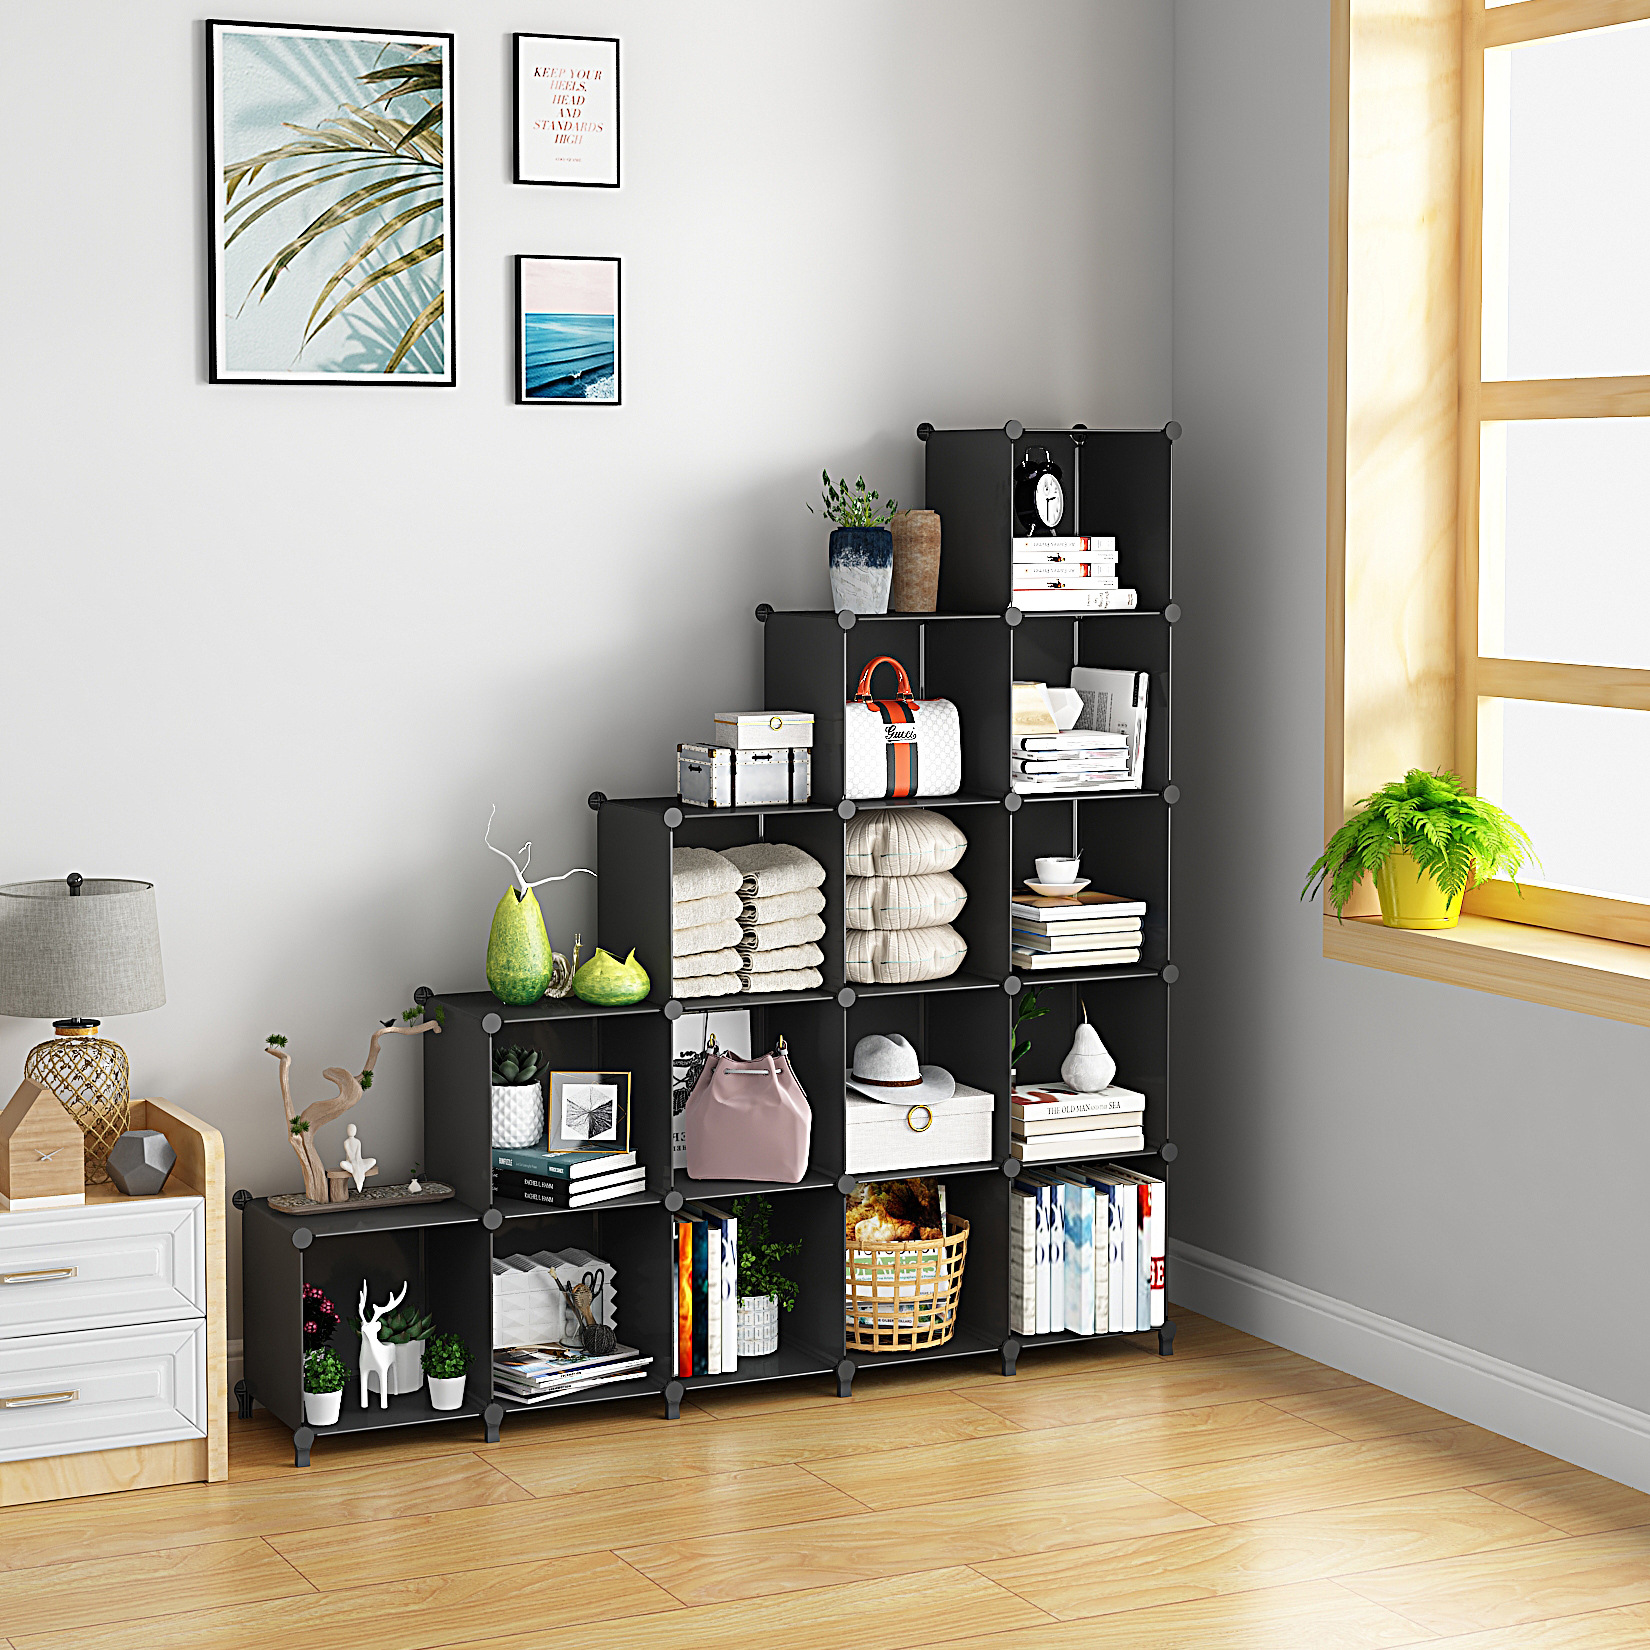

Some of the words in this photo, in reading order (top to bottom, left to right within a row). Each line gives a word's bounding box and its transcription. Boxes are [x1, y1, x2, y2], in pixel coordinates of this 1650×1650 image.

[534, 67, 566, 78] KEEP
[570, 69, 602, 80] YOUR
[552, 94, 586, 106] HEAD
[557, 108, 581, 118] AND
[533, 120, 603, 132] STANDARDS
[554, 134, 583, 145] HIGH
[885, 725, 917, 742] Gucci
[1047, 1107, 1061, 1115] THE
[1061, 1105, 1076, 1113] OLD
[1076, 1103, 1090, 1112] MAN
[1108, 1101, 1121, 1110] SEA
